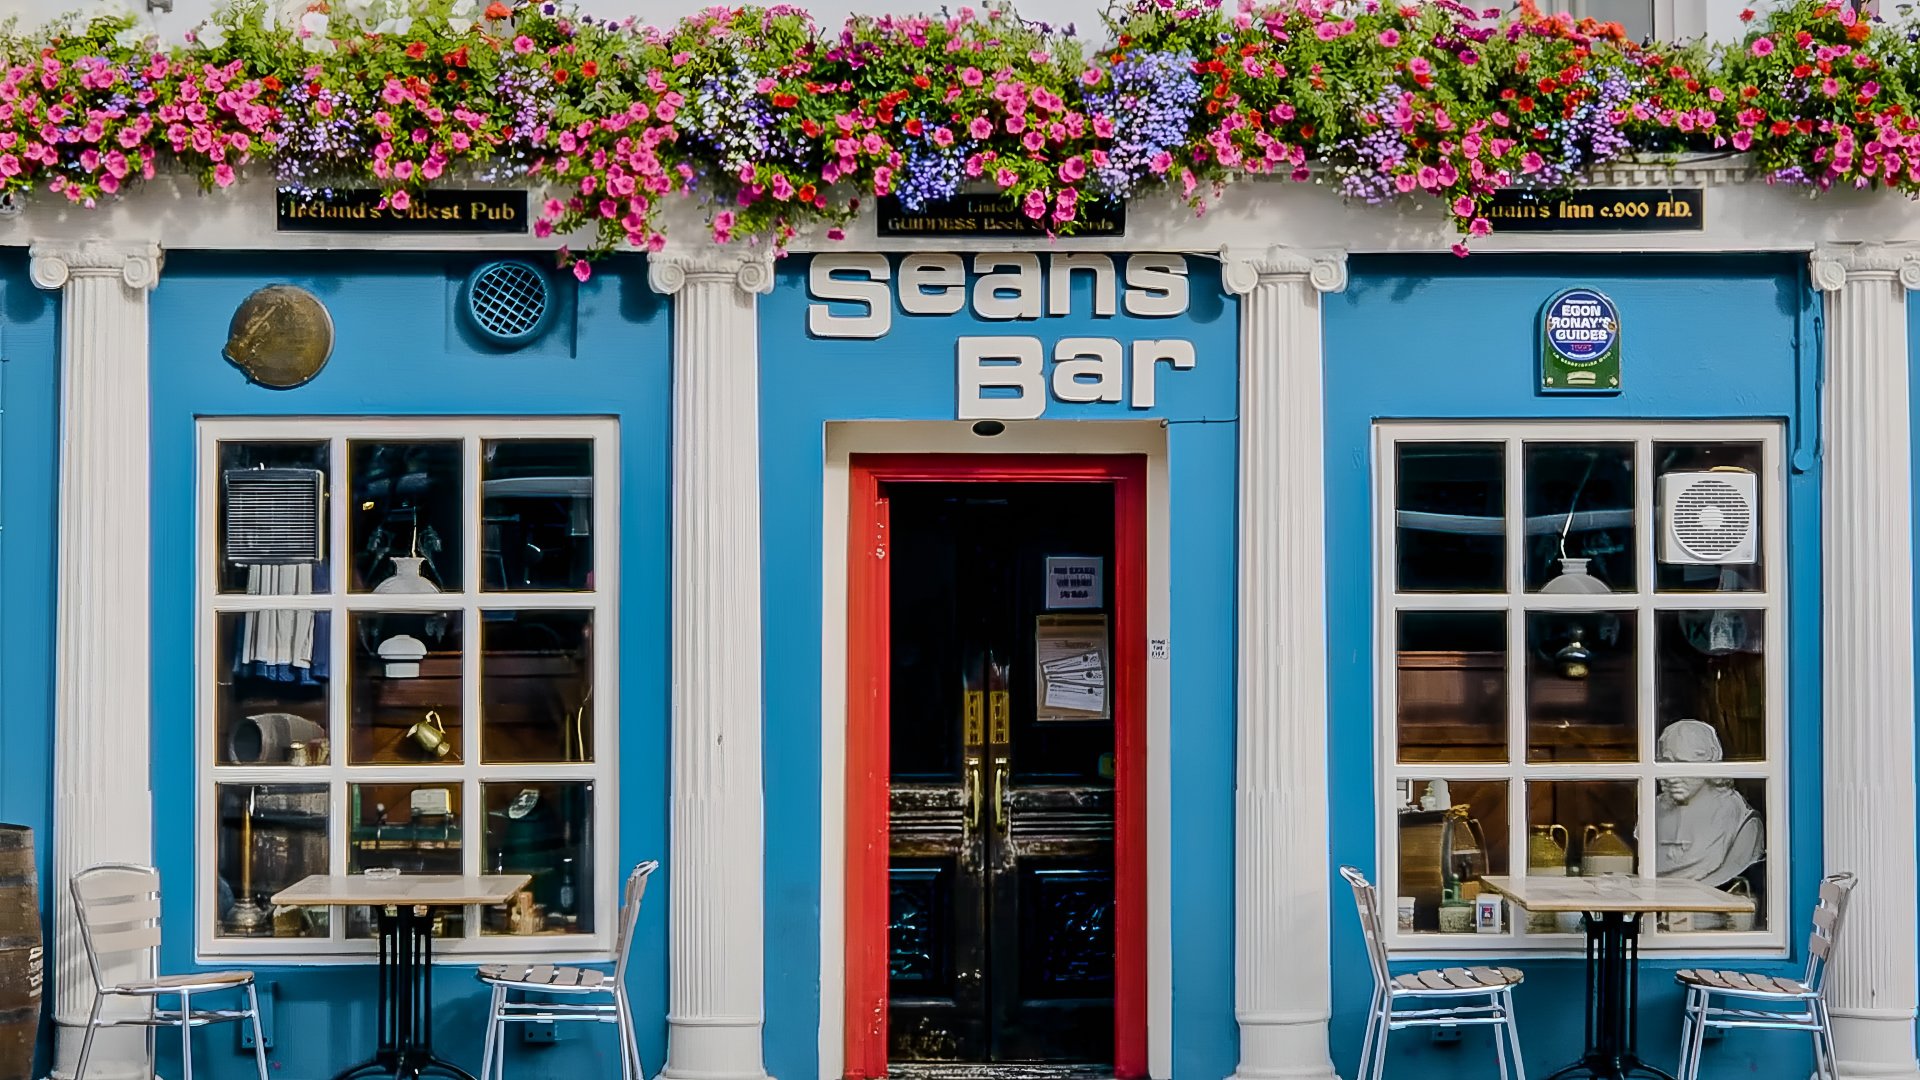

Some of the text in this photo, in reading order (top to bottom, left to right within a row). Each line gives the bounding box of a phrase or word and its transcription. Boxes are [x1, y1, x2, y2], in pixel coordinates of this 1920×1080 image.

[470, 202, 515, 220] Pub
[1559, 200, 1594, 219] Inn
[808, 252, 1191, 338] Seans
[1561, 305, 1601, 317] EGON
[1555, 329, 1608, 341] GUIDES
[957, 335, 1196, 420] Bar
